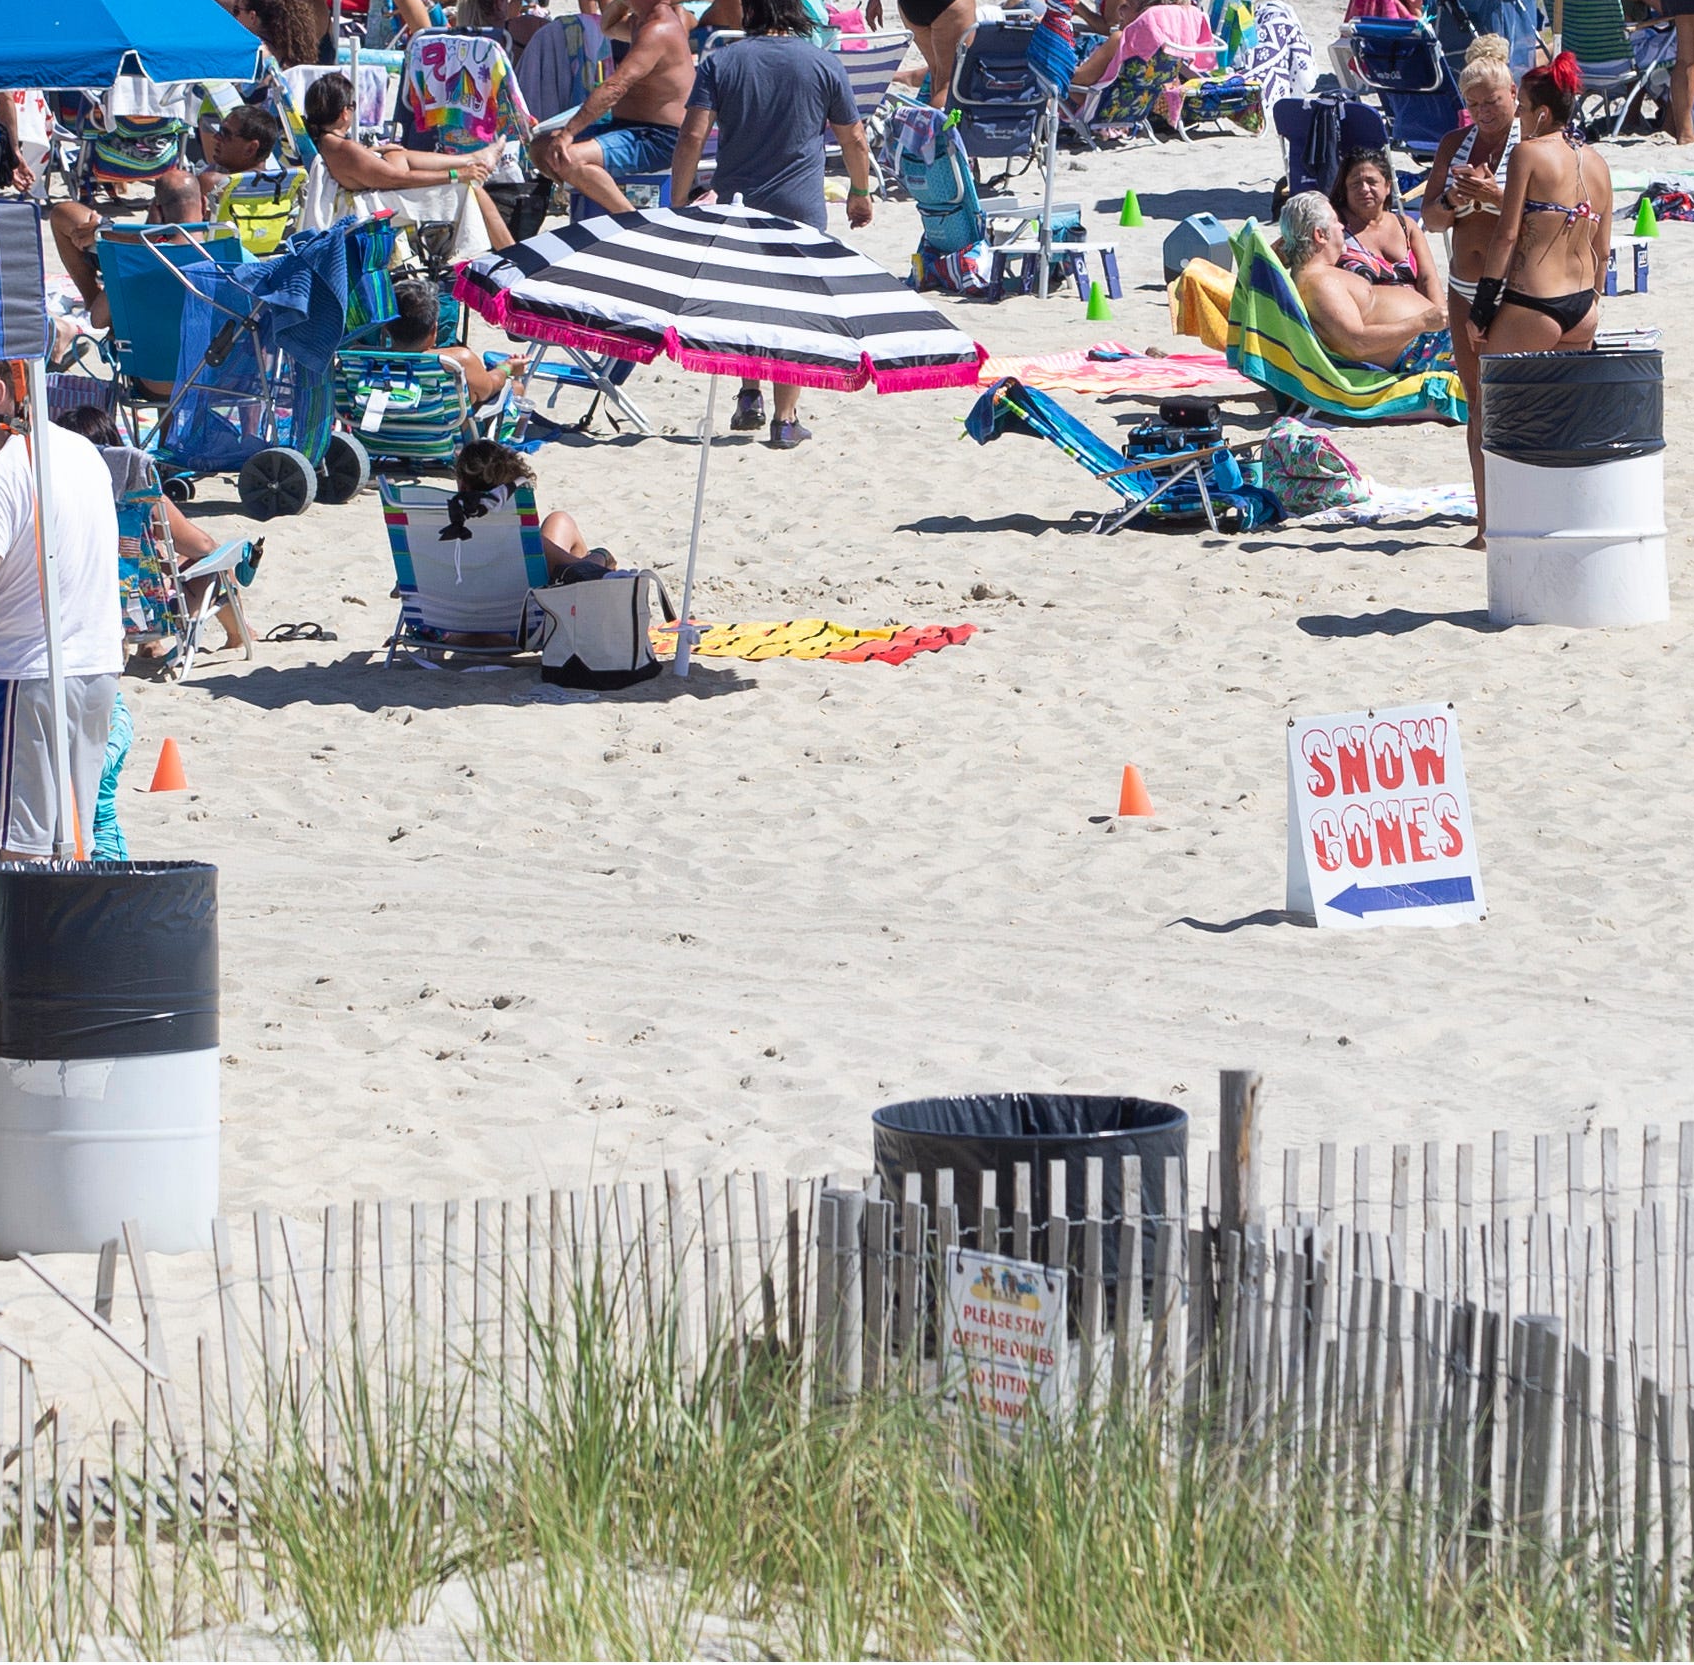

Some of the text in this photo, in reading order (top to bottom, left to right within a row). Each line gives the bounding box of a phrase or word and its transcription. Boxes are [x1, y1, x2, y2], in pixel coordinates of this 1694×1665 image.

[1301, 716, 1448, 798] SNOW
[1309, 792, 1464, 873] CONES
[952, 1329, 980, 1346] OFF
[981, 1335, 1007, 1356] THE
[963, 1304, 1047, 1337] PLEASE STAY
